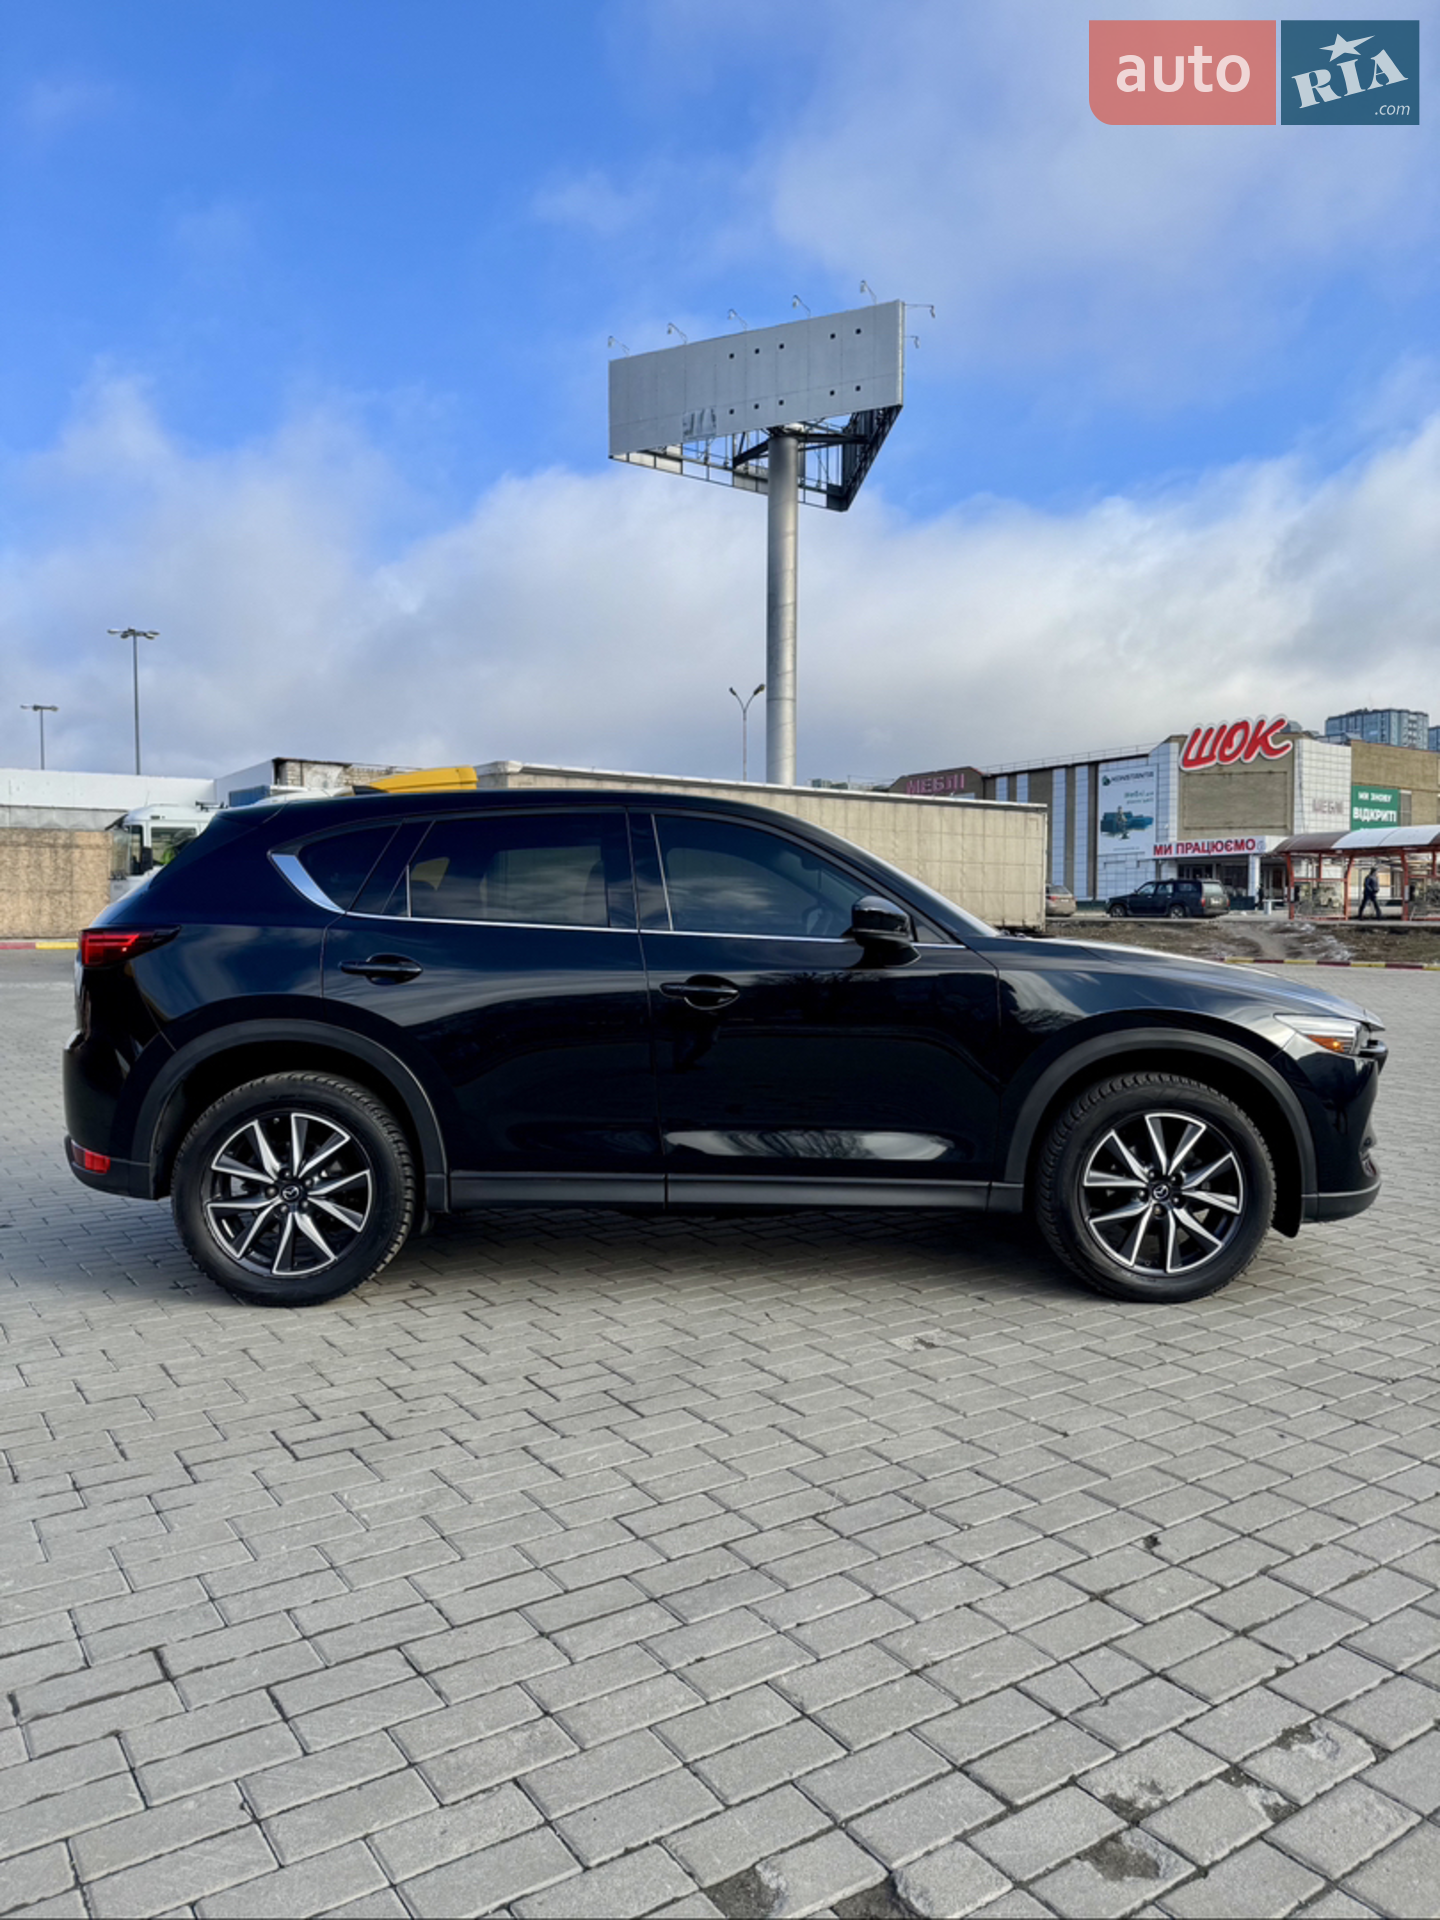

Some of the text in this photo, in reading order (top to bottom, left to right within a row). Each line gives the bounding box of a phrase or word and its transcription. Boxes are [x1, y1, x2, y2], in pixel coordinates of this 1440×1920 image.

[1179, 717, 1293, 770] ШОК
[906, 773, 965, 796] МЕБЛІ
[1358, 791, 1369, 800] МИ
[1353, 807, 1397, 823] ВІДКРИТІ
[1153, 838, 1256, 857] МИ ПРАЦЮЄМО
